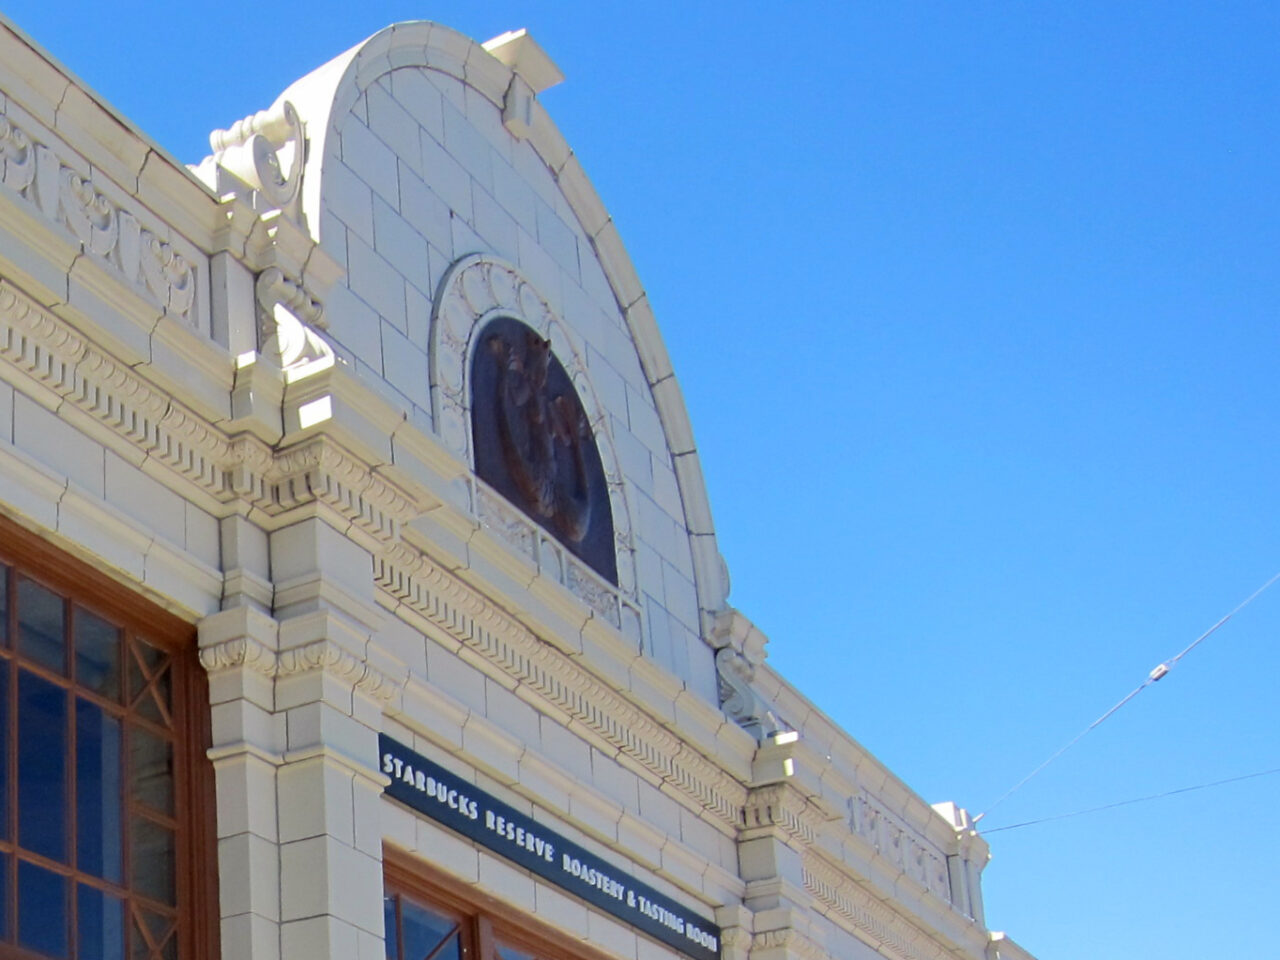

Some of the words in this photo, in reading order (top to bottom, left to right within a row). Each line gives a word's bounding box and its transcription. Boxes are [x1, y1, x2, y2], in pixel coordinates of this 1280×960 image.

[382, 753, 478, 820] STARBUCKS
[485, 810, 555, 862] RESERVE
[562, 853, 625, 900] ROASTERY
[626, 890, 637, 907] &
[637, 895, 685, 934] TASTING
[685, 922, 718, 952] ROOM
